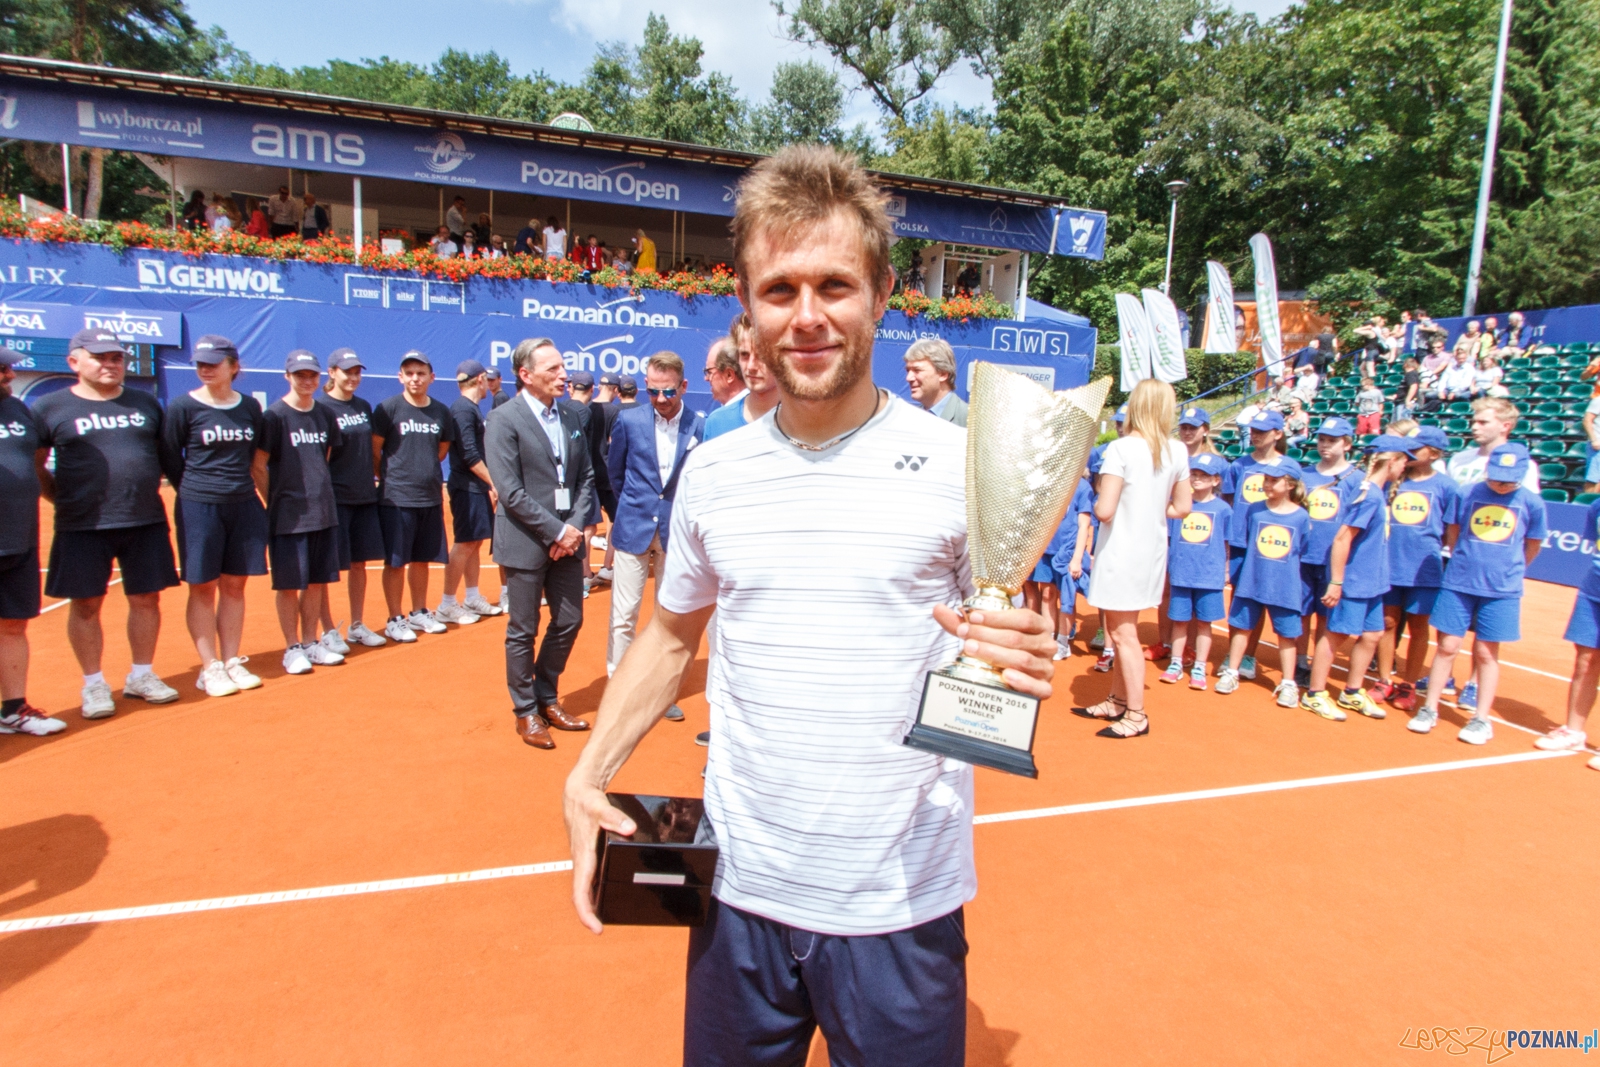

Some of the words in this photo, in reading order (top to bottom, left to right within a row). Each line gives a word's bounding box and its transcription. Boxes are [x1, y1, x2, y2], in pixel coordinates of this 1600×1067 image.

[98, 107, 203, 138] wyborcza.pl
[251, 123, 366, 167] ams
[415, 171, 450, 181] POLSKIE
[450, 175, 477, 184] RADIO
[614, 171, 680, 203] Open
[895, 221, 930, 233] POLSKA
[168, 264, 285, 294] GEHWOL
[352, 288, 380, 299] YTONG
[84, 316, 164, 338] DAVOSA
[6, 339, 34, 352] BOT
[75, 411, 129, 436] plus
[336, 412, 362, 431] plus
[400, 419, 432, 435] plus
[202, 425, 245, 446] plus
[290, 428, 319, 448] plus
[938, 681, 976, 697] POZNAŃ
[978, 691, 1003, 704] OPEN
[1005, 698, 1028, 710] 2016
[958, 696, 1004, 715] WINNER
[963, 707, 996, 720] SINGLES
[980, 722, 1000, 733] Open
